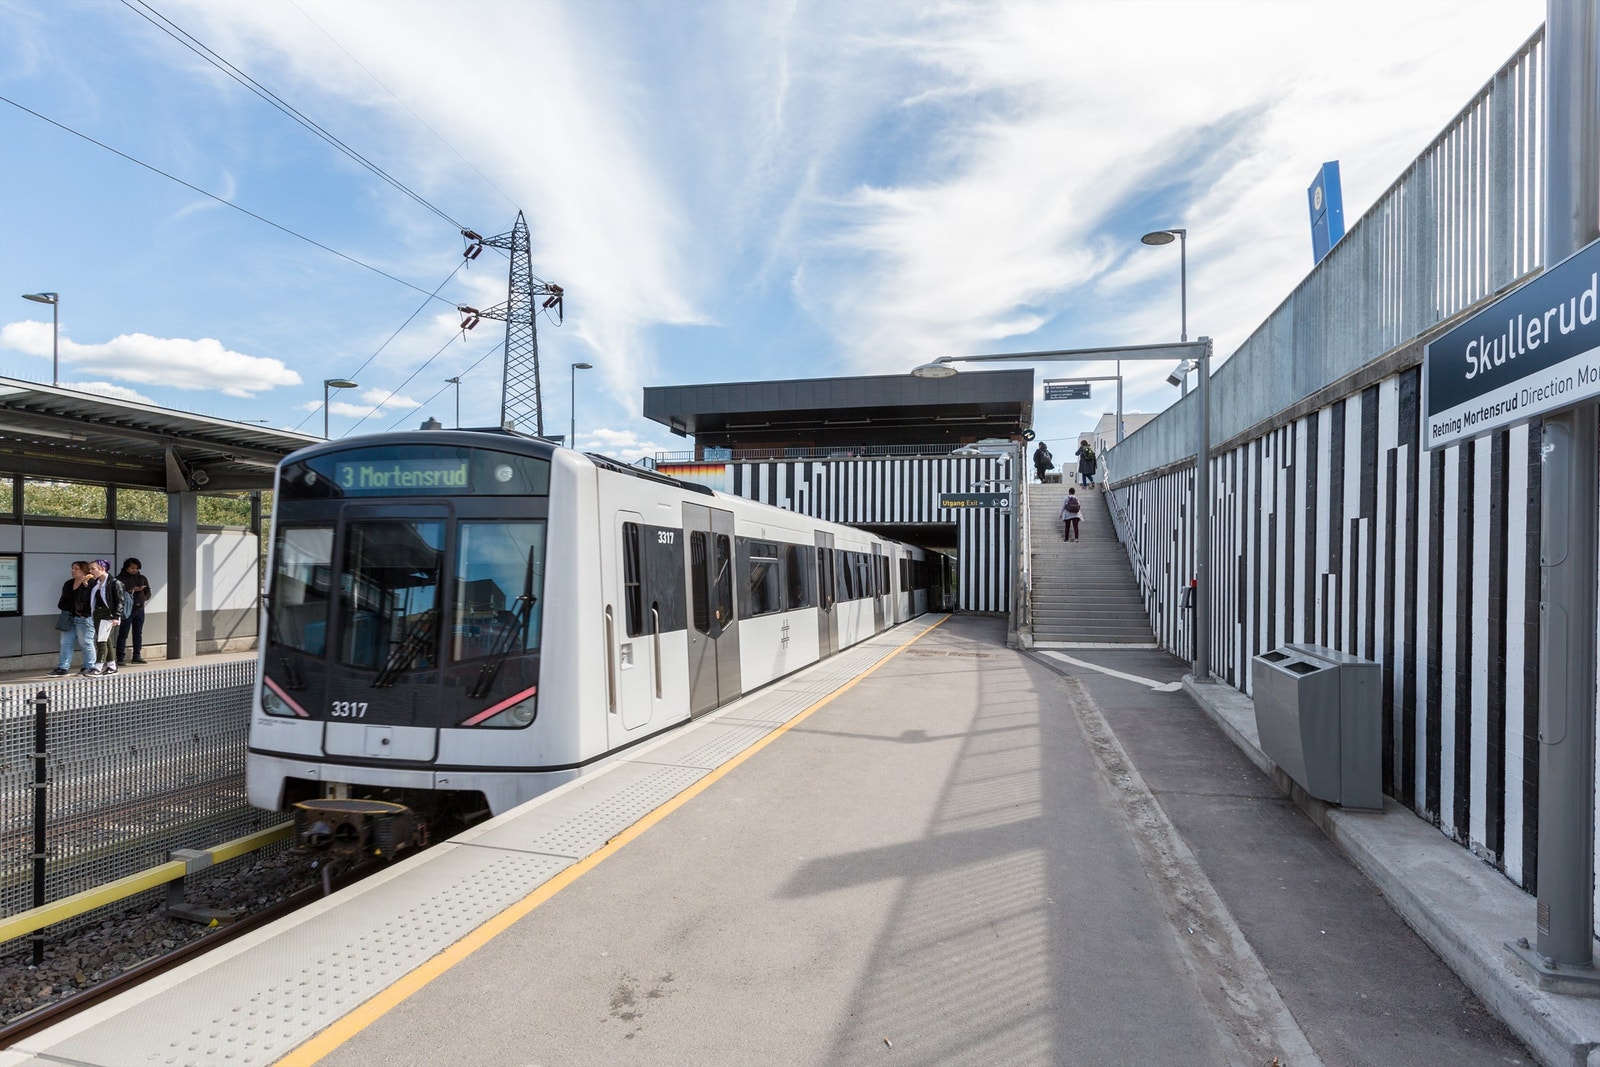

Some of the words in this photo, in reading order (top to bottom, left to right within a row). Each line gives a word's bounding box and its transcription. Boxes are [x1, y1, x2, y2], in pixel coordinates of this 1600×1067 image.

[1465, 272, 1598, 380] Skullerud
[1432, 418, 1462, 439] Retning
[1464, 393, 1518, 426] Mortensrud
[1521, 377, 1573, 407] Direction
[1578, 365, 1600, 387] Mo
[342, 466, 354, 488] 3
[360, 463, 467, 487] Mortensrud
[657, 530, 674, 544] 3317
[331, 701, 368, 718] 3317
